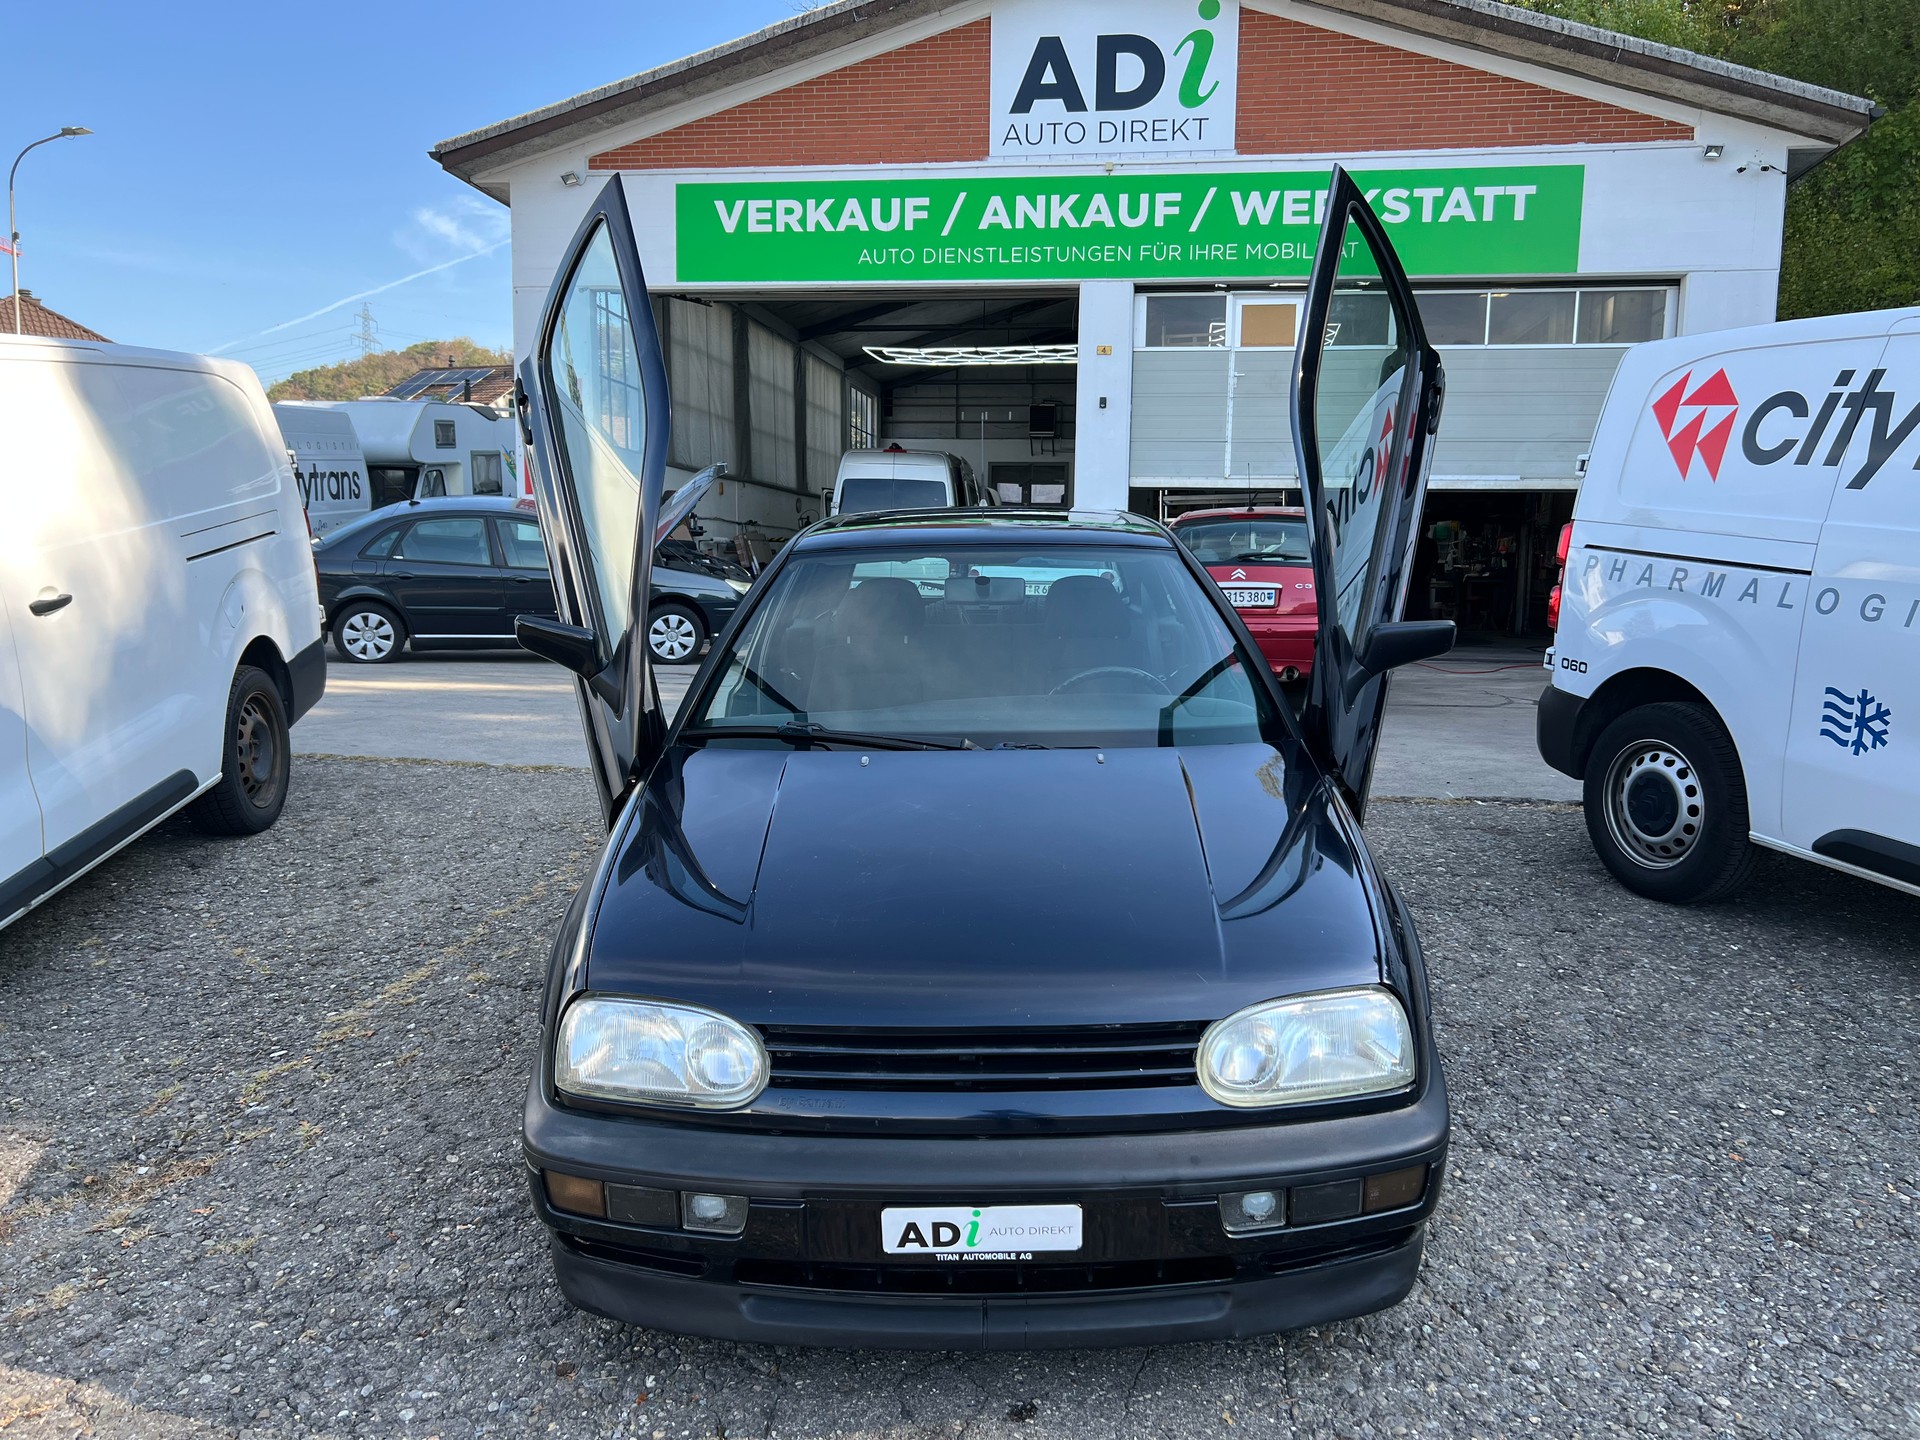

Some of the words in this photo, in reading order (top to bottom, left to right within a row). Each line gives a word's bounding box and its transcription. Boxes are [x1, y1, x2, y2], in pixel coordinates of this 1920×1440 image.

[1009, 0, 1220, 114] ADi
[1002, 121, 1086, 146] AUTO
[1098, 117, 1210, 144] DIREKT
[713, 197, 930, 233] VERKAUF
[940, 191, 968, 236] /
[977, 192, 1182, 230] ANKAUF
[1188, 187, 1218, 232] /
[1230, 185, 1537, 225] WESTATT
[858, 248, 915, 265] AUTO
[923, 245, 1131, 264] DIENSTLEISTUNGEN
[1139, 241, 1182, 262] FÜR
[1189, 243, 1238, 261] IHRE
[1245, 241, 1360, 260] MOBILT
[896, 1209, 983, 1249] ADi
[989, 1226, 1025, 1236] AUTO
[1028, 1225, 1074, 1236] DIREKT
[935, 1253, 959, 1261] TITAN
[962, 1252, 1017, 1261] AUTOMOBILE
[1019, 1252, 1033, 1260] AG
